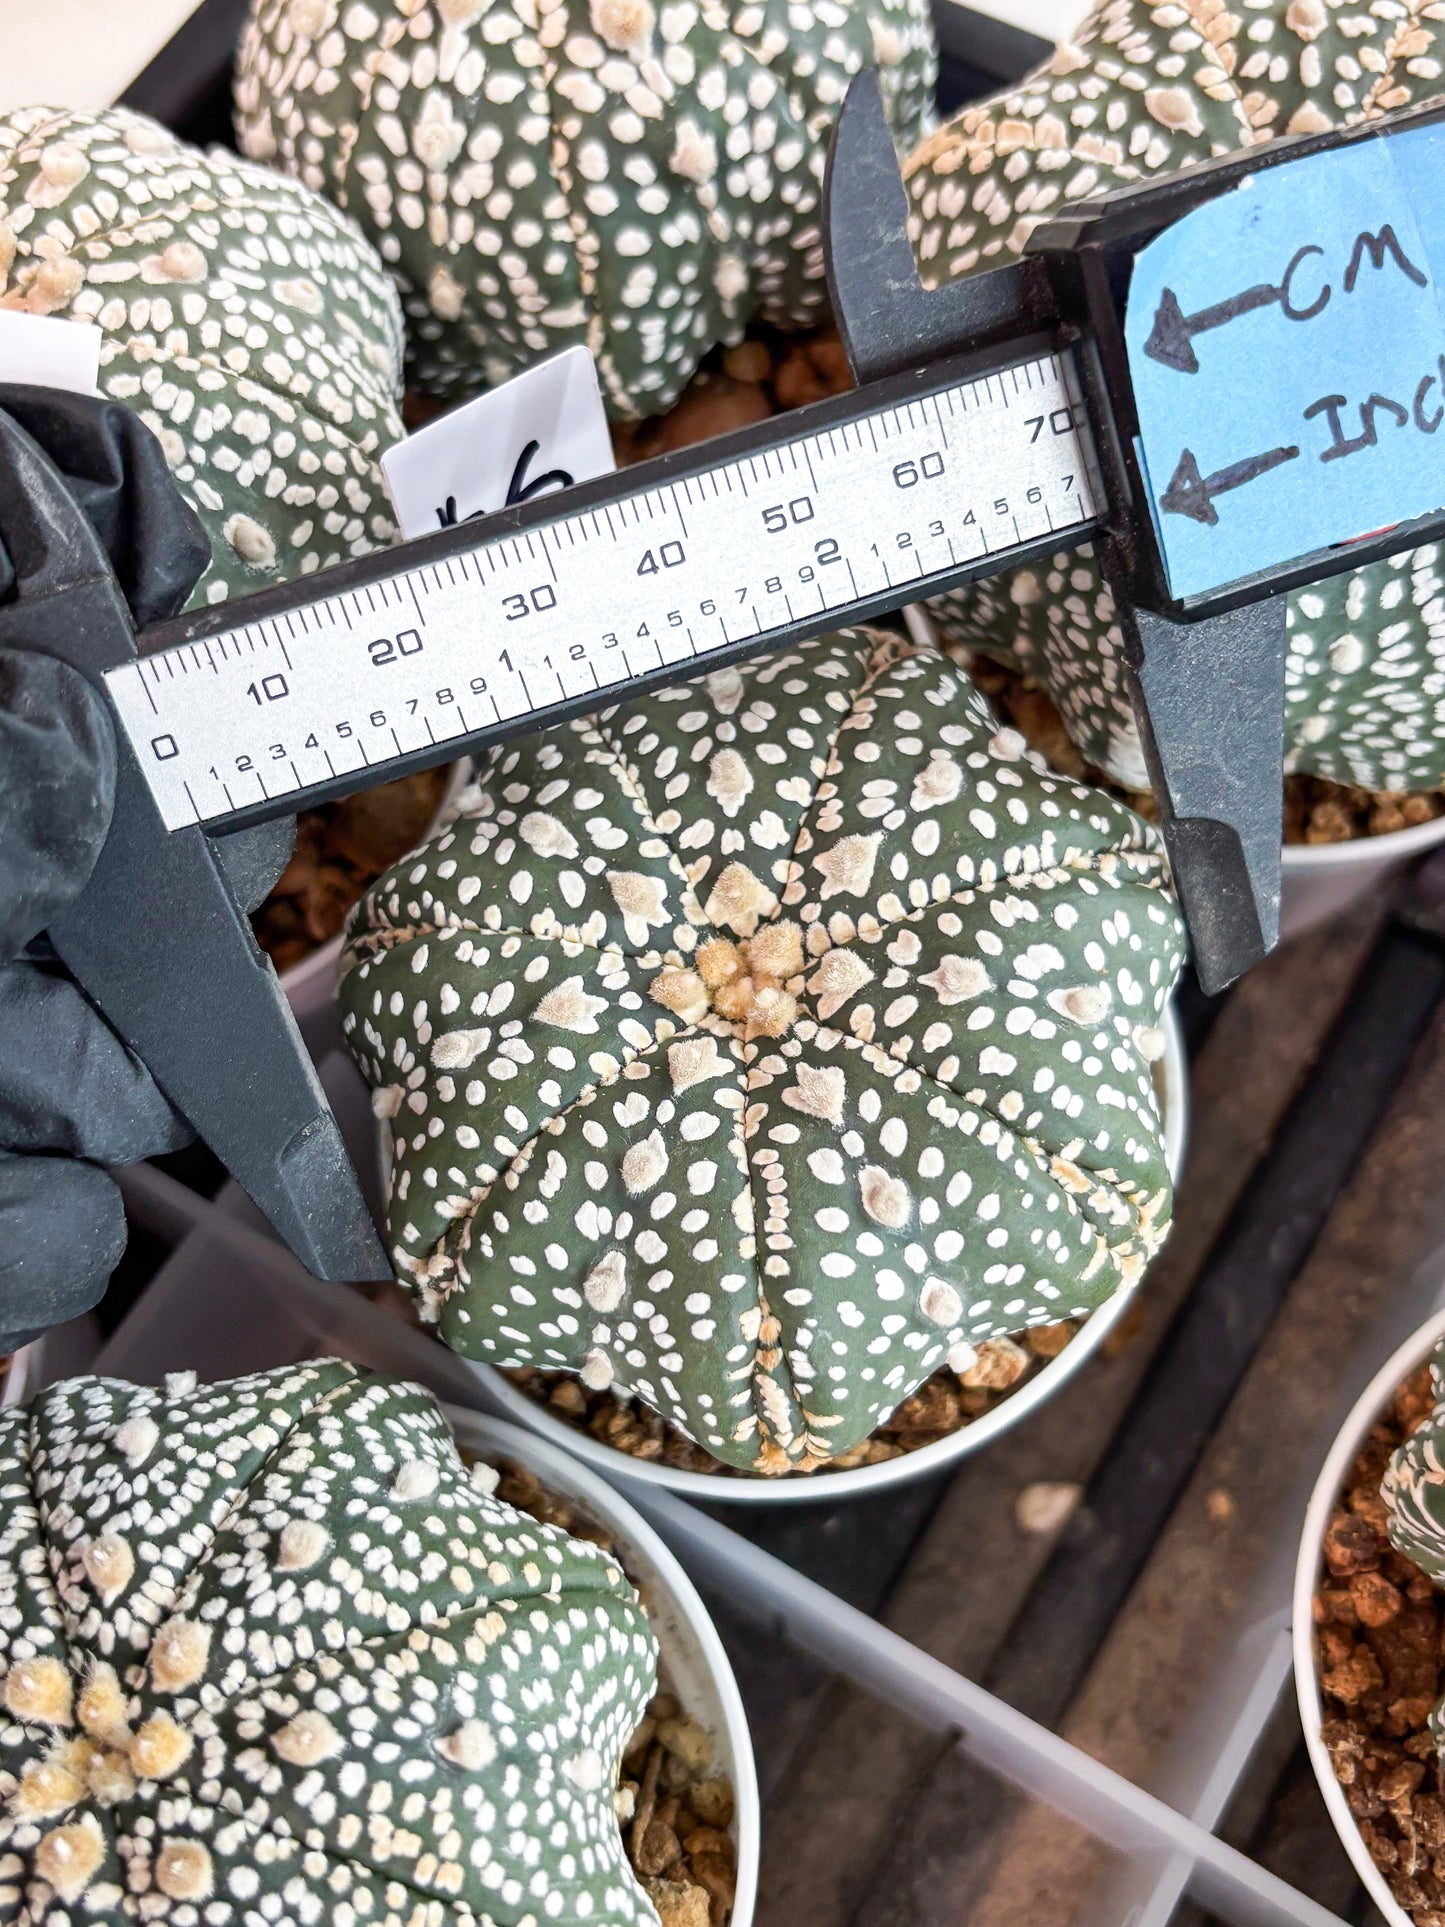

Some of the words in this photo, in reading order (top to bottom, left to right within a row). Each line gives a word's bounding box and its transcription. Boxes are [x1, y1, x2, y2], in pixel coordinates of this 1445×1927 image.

[150, 733, 180, 762] 0
[246, 673, 290, 706] 10
[367, 628, 424, 667] 20
[501, 584, 557, 621] 30
[636, 540, 686, 576] 40
[761, 496, 815, 534] 50
[892, 451, 945, 489] 60
[1023, 407, 1075, 444] 70
[209, 766, 219, 780] 1
[235, 755, 254, 773] 2
[268, 743, 287, 760] 3
[304, 732, 320, 749] 4
[335, 721, 353, 739] 5
[369, 710, 387, 727] 6
[405, 698, 418, 715] 7
[435, 687, 455, 705] 8
[469, 677, 488, 695] 9
[498, 649, 514, 672] 1
[543, 655, 553, 669] 1
[568, 644, 587, 661] 2
[602, 632, 619, 649] 3
[636, 622, 650, 638] 4
[667, 610, 683, 627] 5
[699, 599, 716, 616] 6
[735, 587, 747, 604] 7
[764, 576, 783, 594] 8
[798, 565, 815, 583] 9
[814, 538, 842, 566] 2
[871, 543, 879, 557] 1
[896, 532, 913, 549] 2
[928, 520, 945, 537] 3
[962, 509, 977, 526] 4
[993, 497, 1009, 516] 5
[1026, 486, 1042, 504] 6
[1061, 474, 1074, 492] 7
